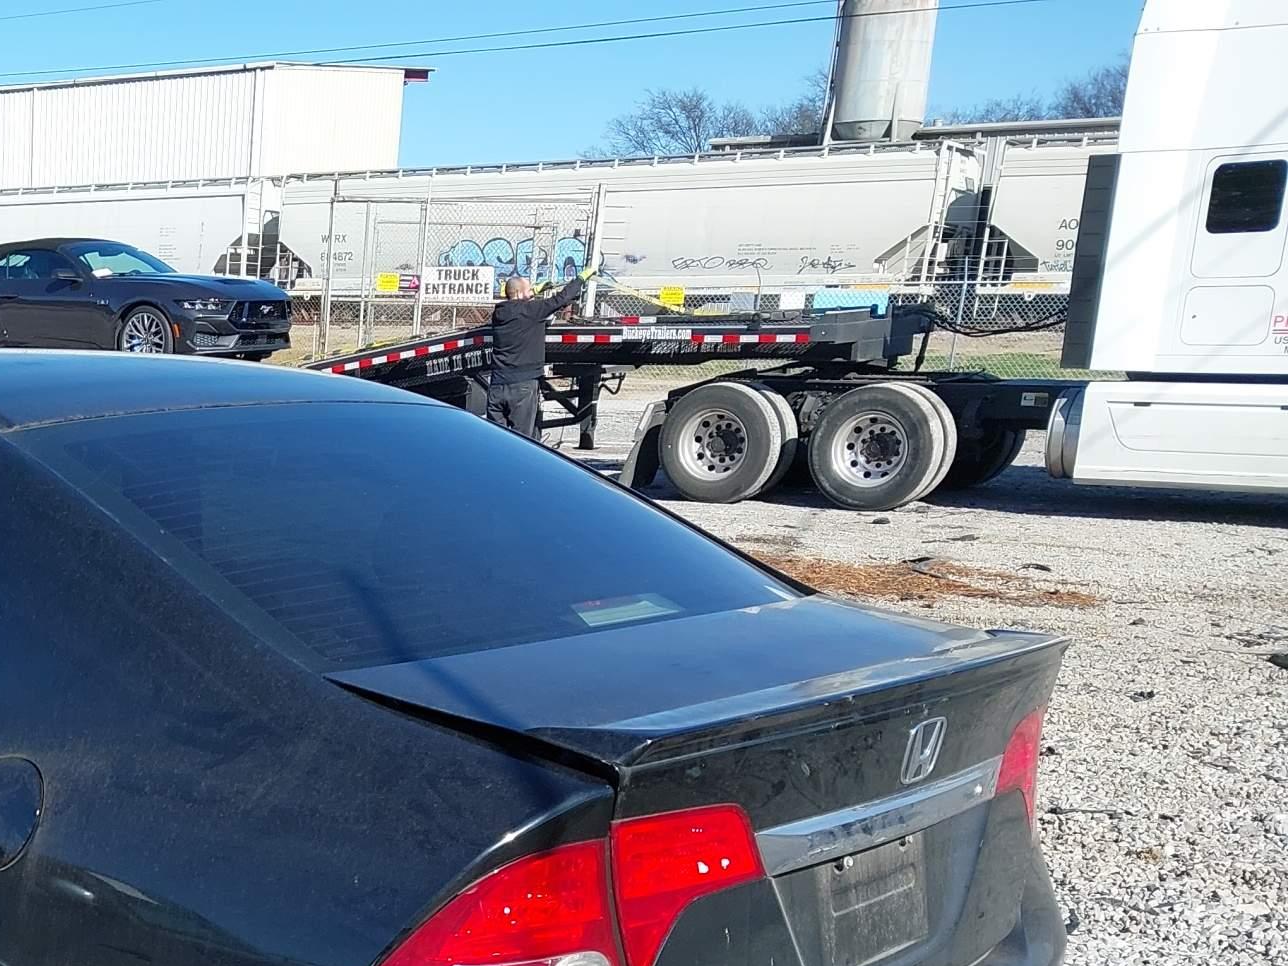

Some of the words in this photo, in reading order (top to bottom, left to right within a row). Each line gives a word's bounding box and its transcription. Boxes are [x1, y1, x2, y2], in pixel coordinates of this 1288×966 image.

[320, 234, 347, 244] WRX
[437, 268, 480, 281] TRUCK
[424, 282, 490, 295] ENTRANCE
[622, 326, 692, 342] BuckeyeTrailers.com
[425, 356, 451, 377] MADE
[452, 354, 463, 372] IN
[465, 350, 483, 369] THE
